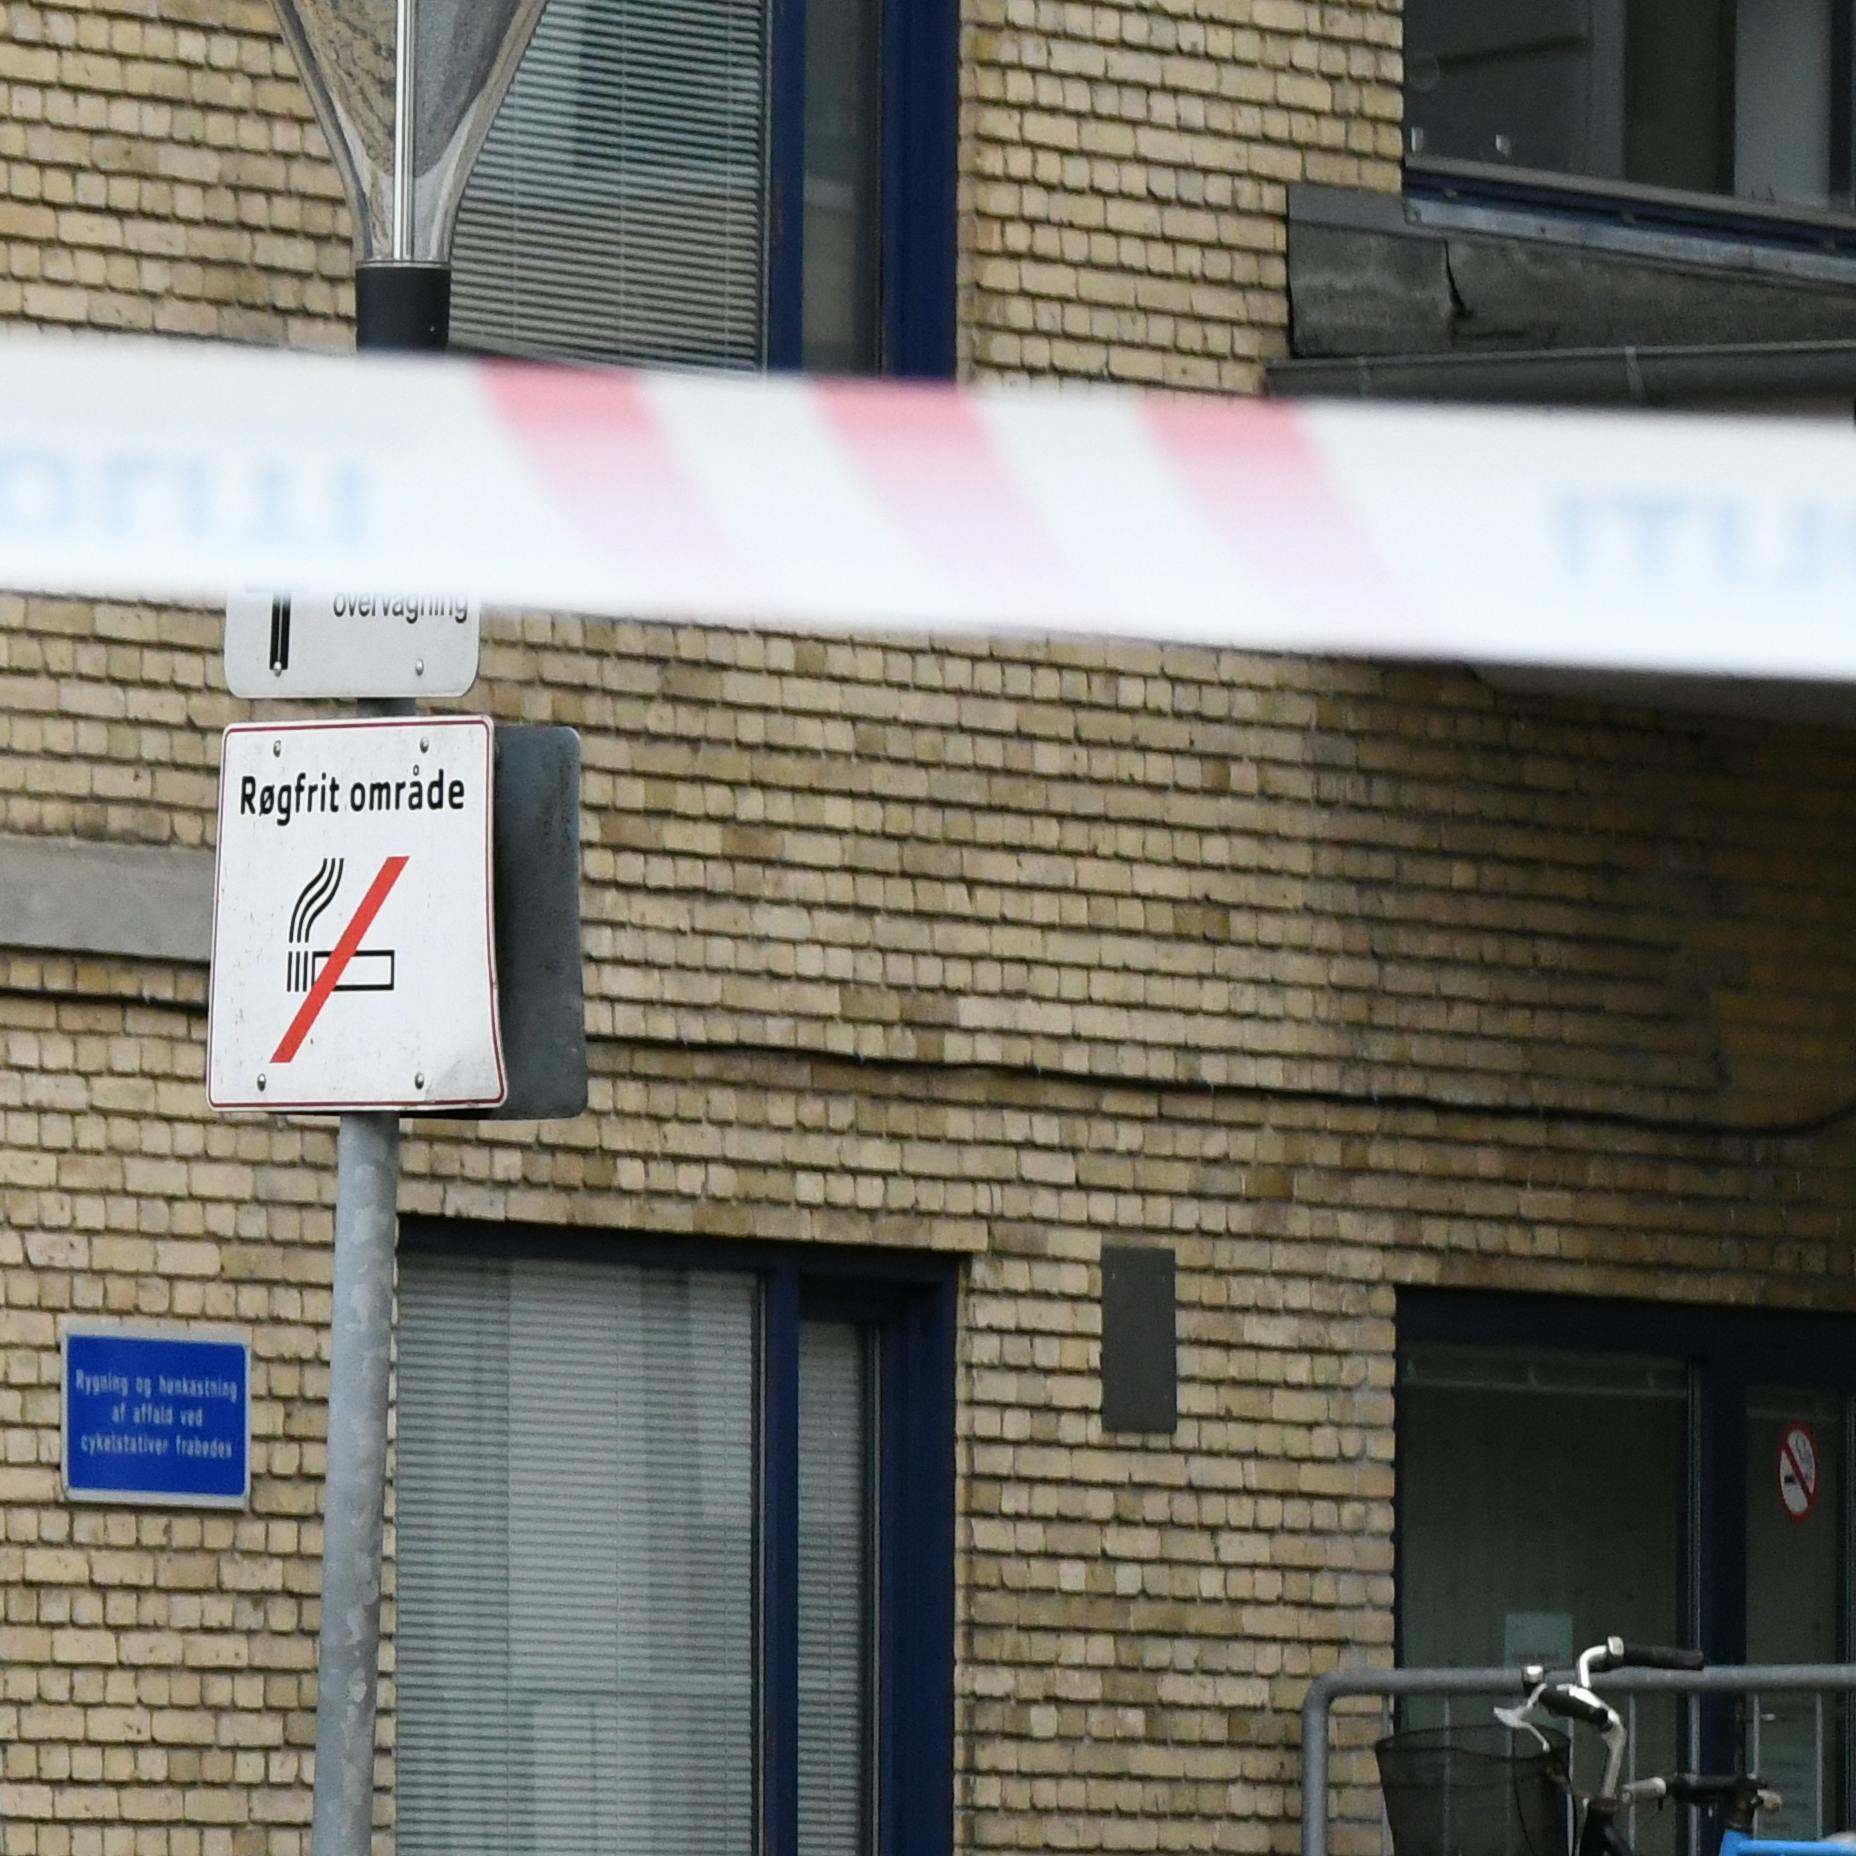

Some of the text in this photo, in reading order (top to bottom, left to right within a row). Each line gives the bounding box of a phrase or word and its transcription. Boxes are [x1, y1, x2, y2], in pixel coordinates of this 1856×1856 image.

[239, 764, 466, 826] Røgfrit område
[75, 1369, 129, 1397] Rygning
[136, 1377, 152, 1399] og
[112, 1402, 204, 1427] af affald ved
